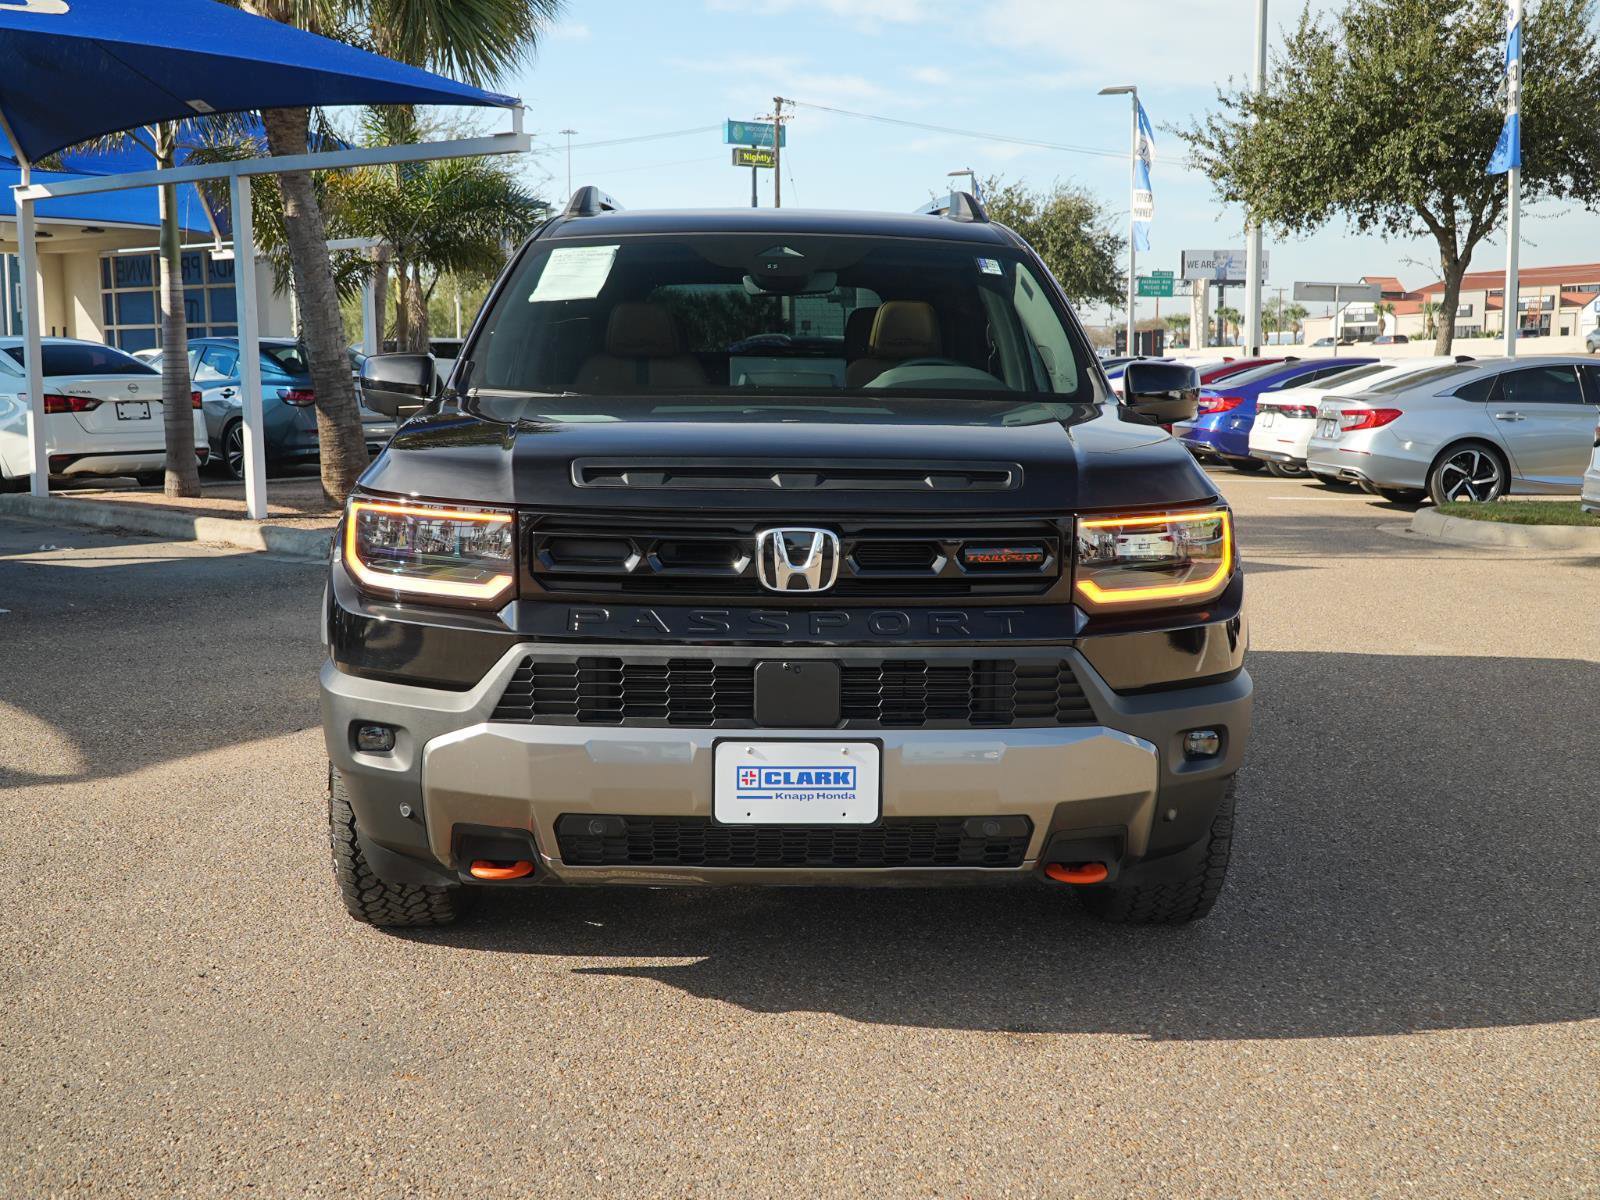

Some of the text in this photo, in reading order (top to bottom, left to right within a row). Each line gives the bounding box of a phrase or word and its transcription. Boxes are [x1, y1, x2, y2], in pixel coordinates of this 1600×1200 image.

[1187, 260, 1216, 269] WE ARE
[566, 608, 1025, 635] PASSPORT
[764, 771, 850, 785] CLARK
[775, 792, 856, 801] Knapp Honda
